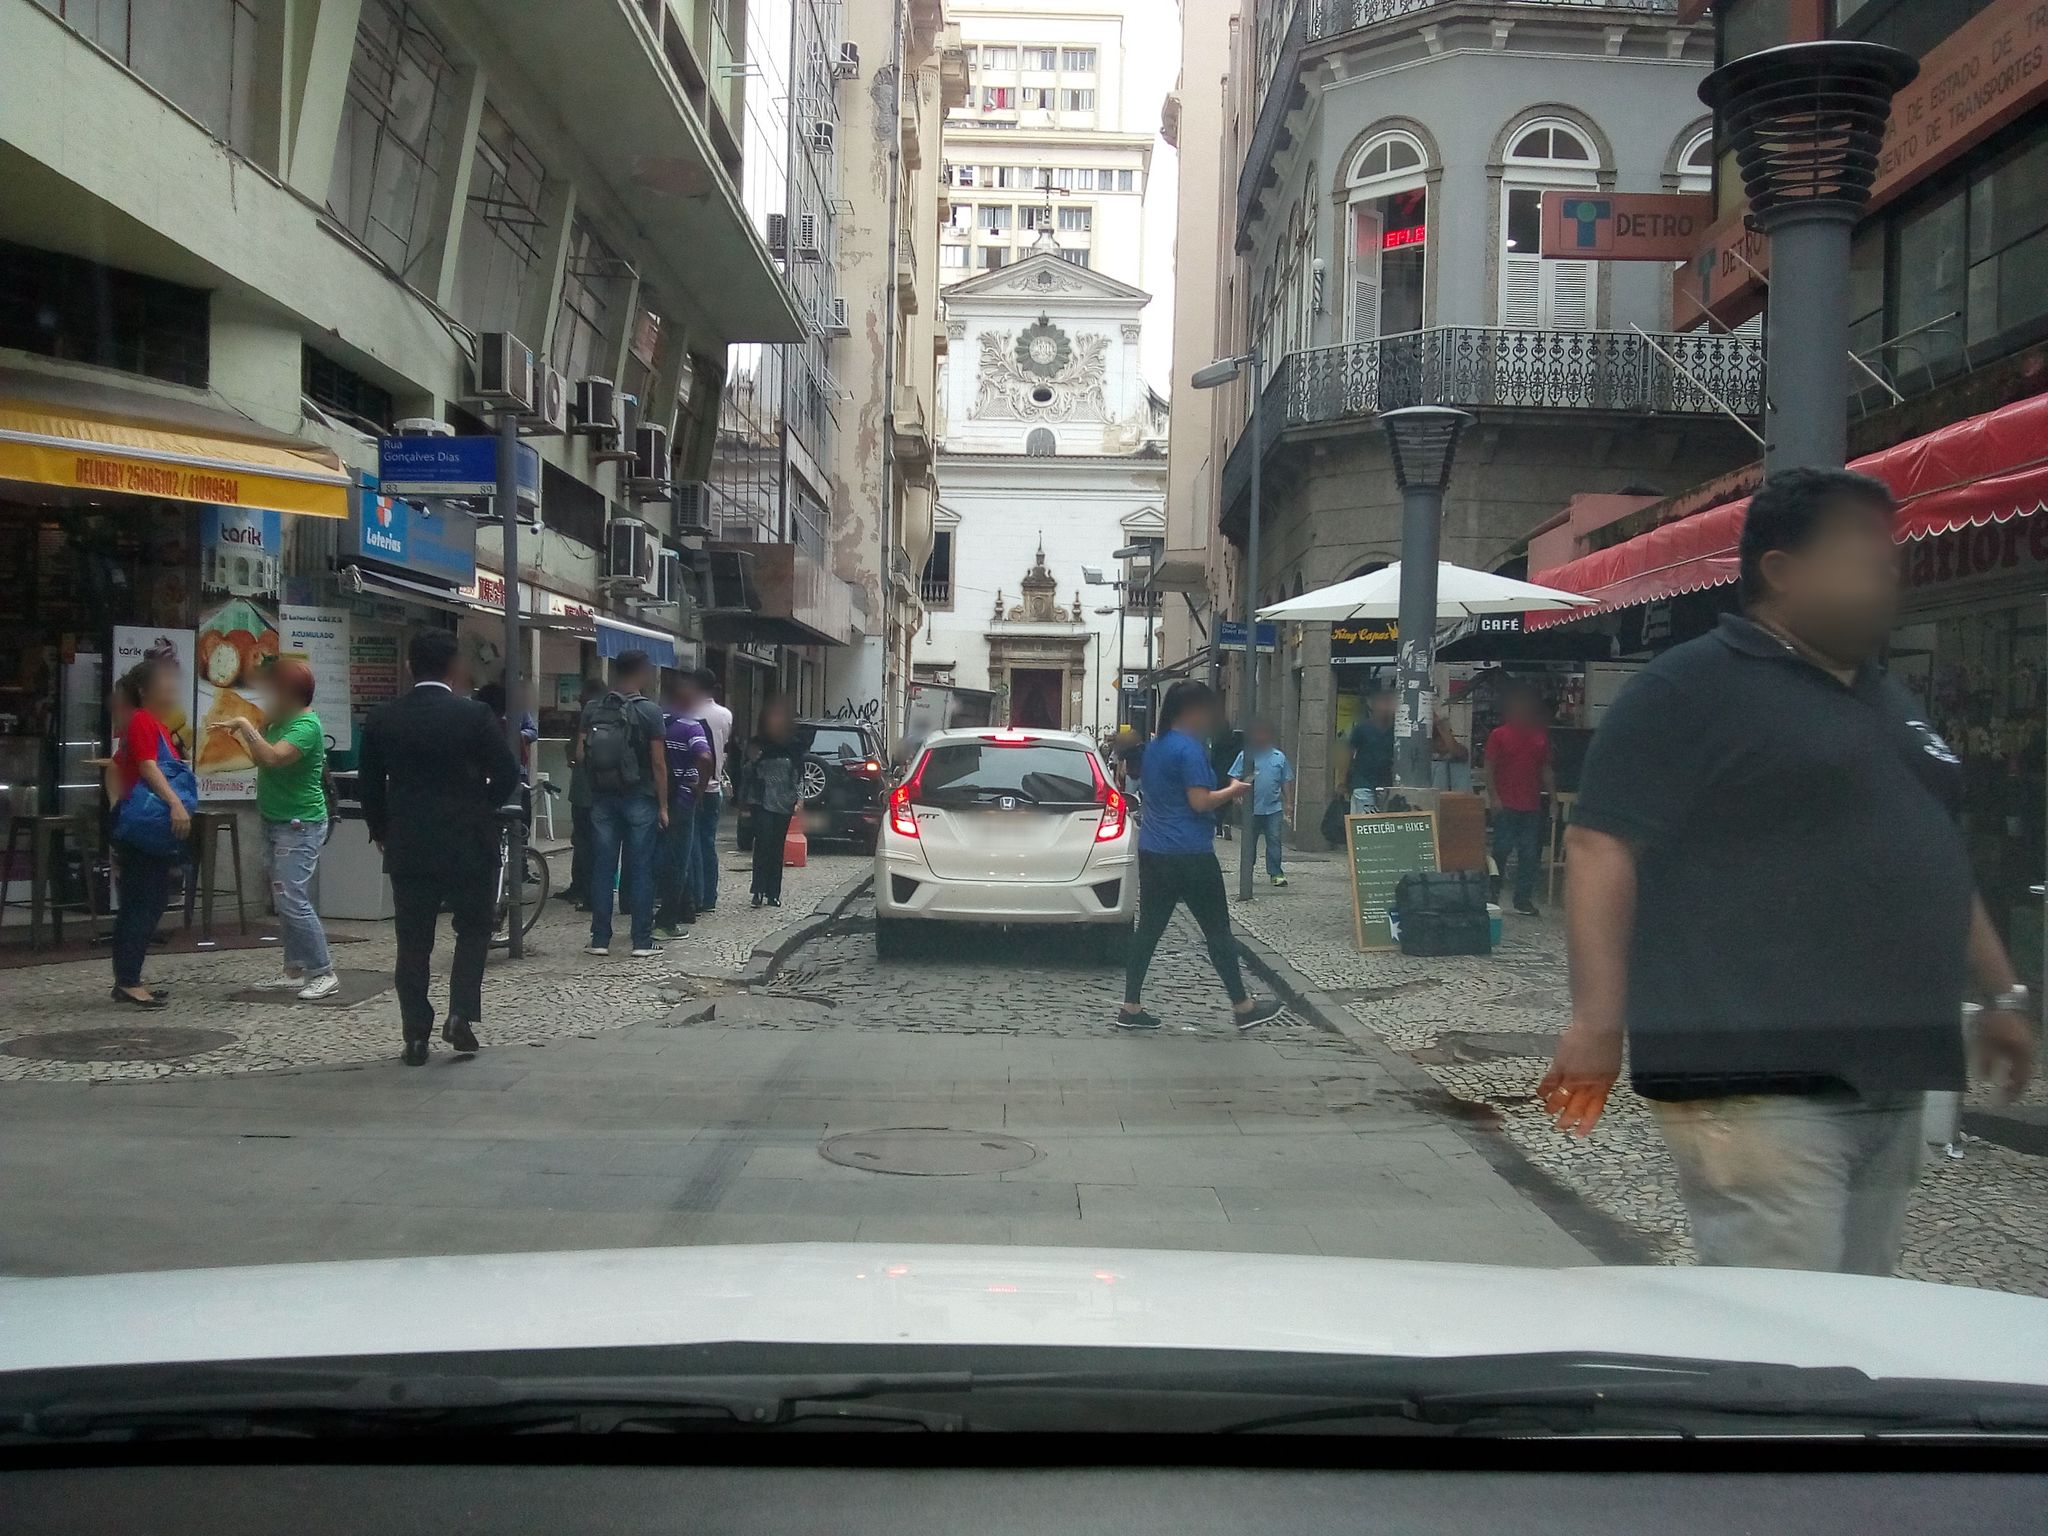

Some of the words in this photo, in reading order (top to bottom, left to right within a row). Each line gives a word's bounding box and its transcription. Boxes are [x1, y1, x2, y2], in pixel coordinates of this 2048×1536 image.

[1948, 44, 2043, 129] TRANSPORTES
[1616, 213, 1693, 238] DETRO
[383, 439, 403, 450] Rua
[383, 451, 435, 464] Gonçalves
[437, 452, 460, 463] Dias
[75, 457, 125, 488] DELIVERY
[385, 484, 398, 494] 83
[479, 484, 493, 495] 89
[221, 521, 263, 546] tarik
[366, 527, 401, 553] Loterias
[1481, 617, 1519, 631] CAFÉ
[1405, 822, 1425, 832] BIKE
